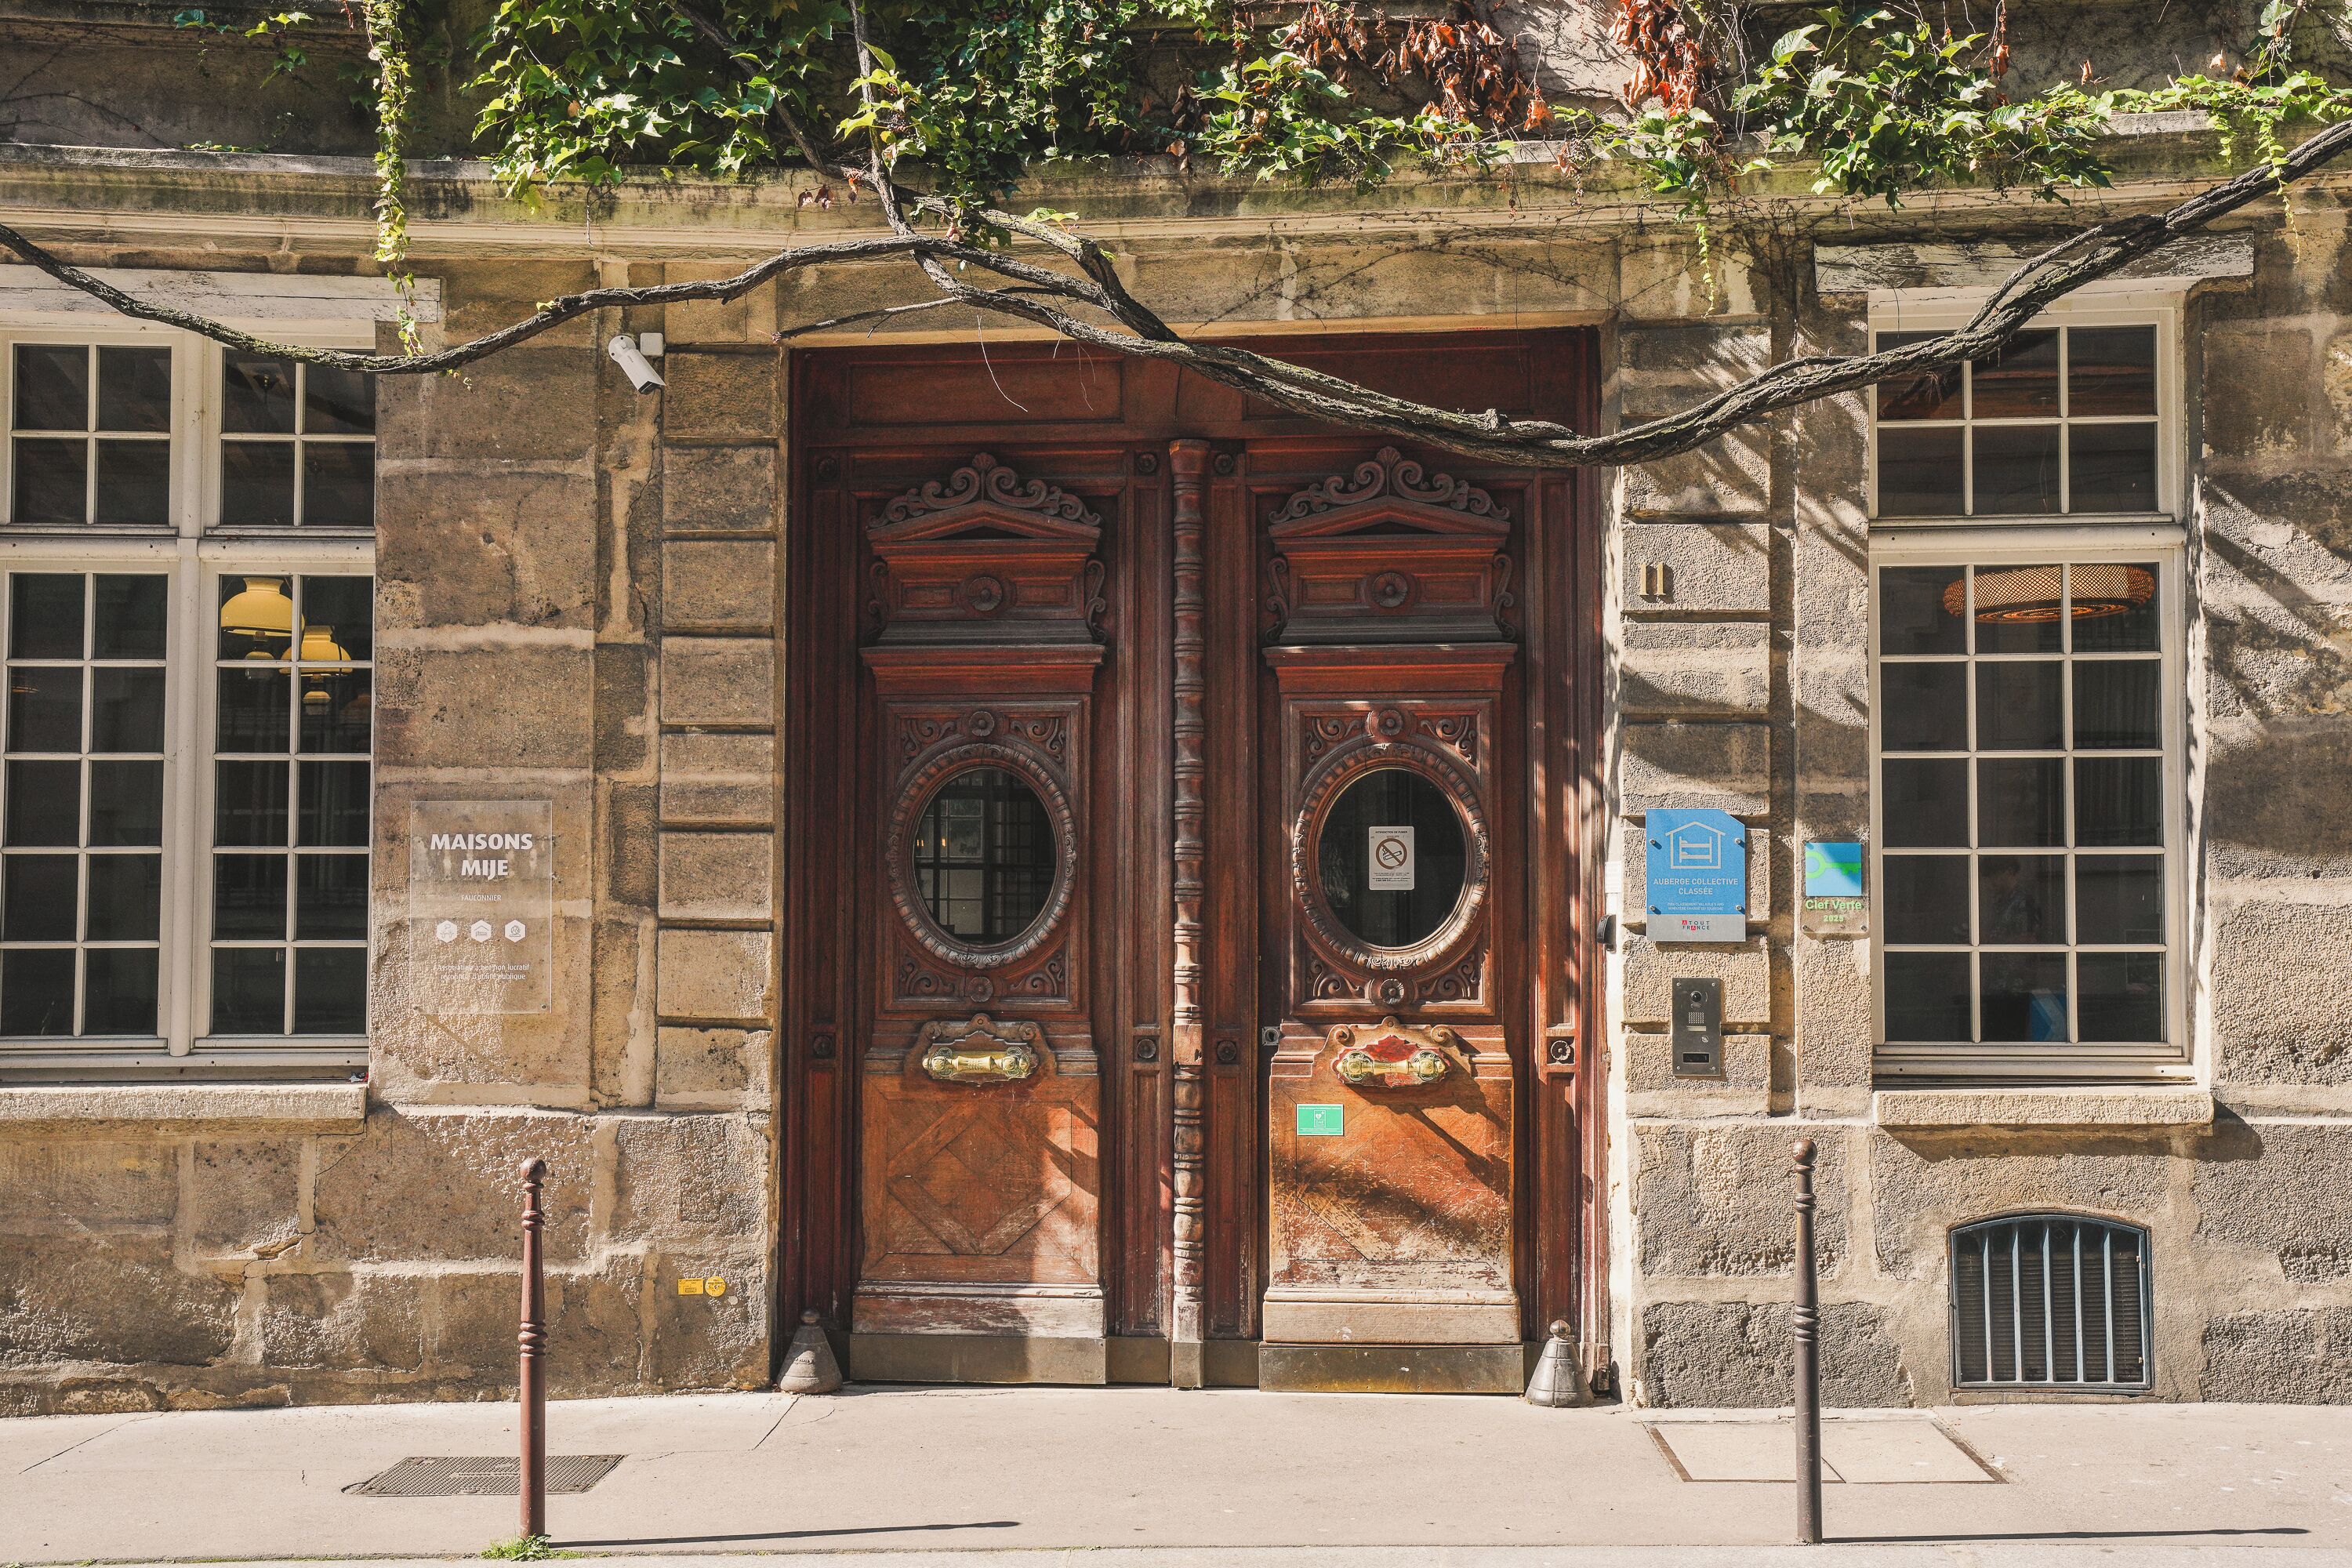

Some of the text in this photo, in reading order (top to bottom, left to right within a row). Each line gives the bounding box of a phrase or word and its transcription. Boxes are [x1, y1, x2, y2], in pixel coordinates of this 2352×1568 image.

[1639, 561, 1666, 596] 11
[430, 833, 533, 850] MAISONS
[461, 859, 509, 880] MIJE
[1679, 886, 1713, 895] CLASSÉE
[1806, 900, 1862, 909] Clef Verte
[498, 972, 526, 982] publique
